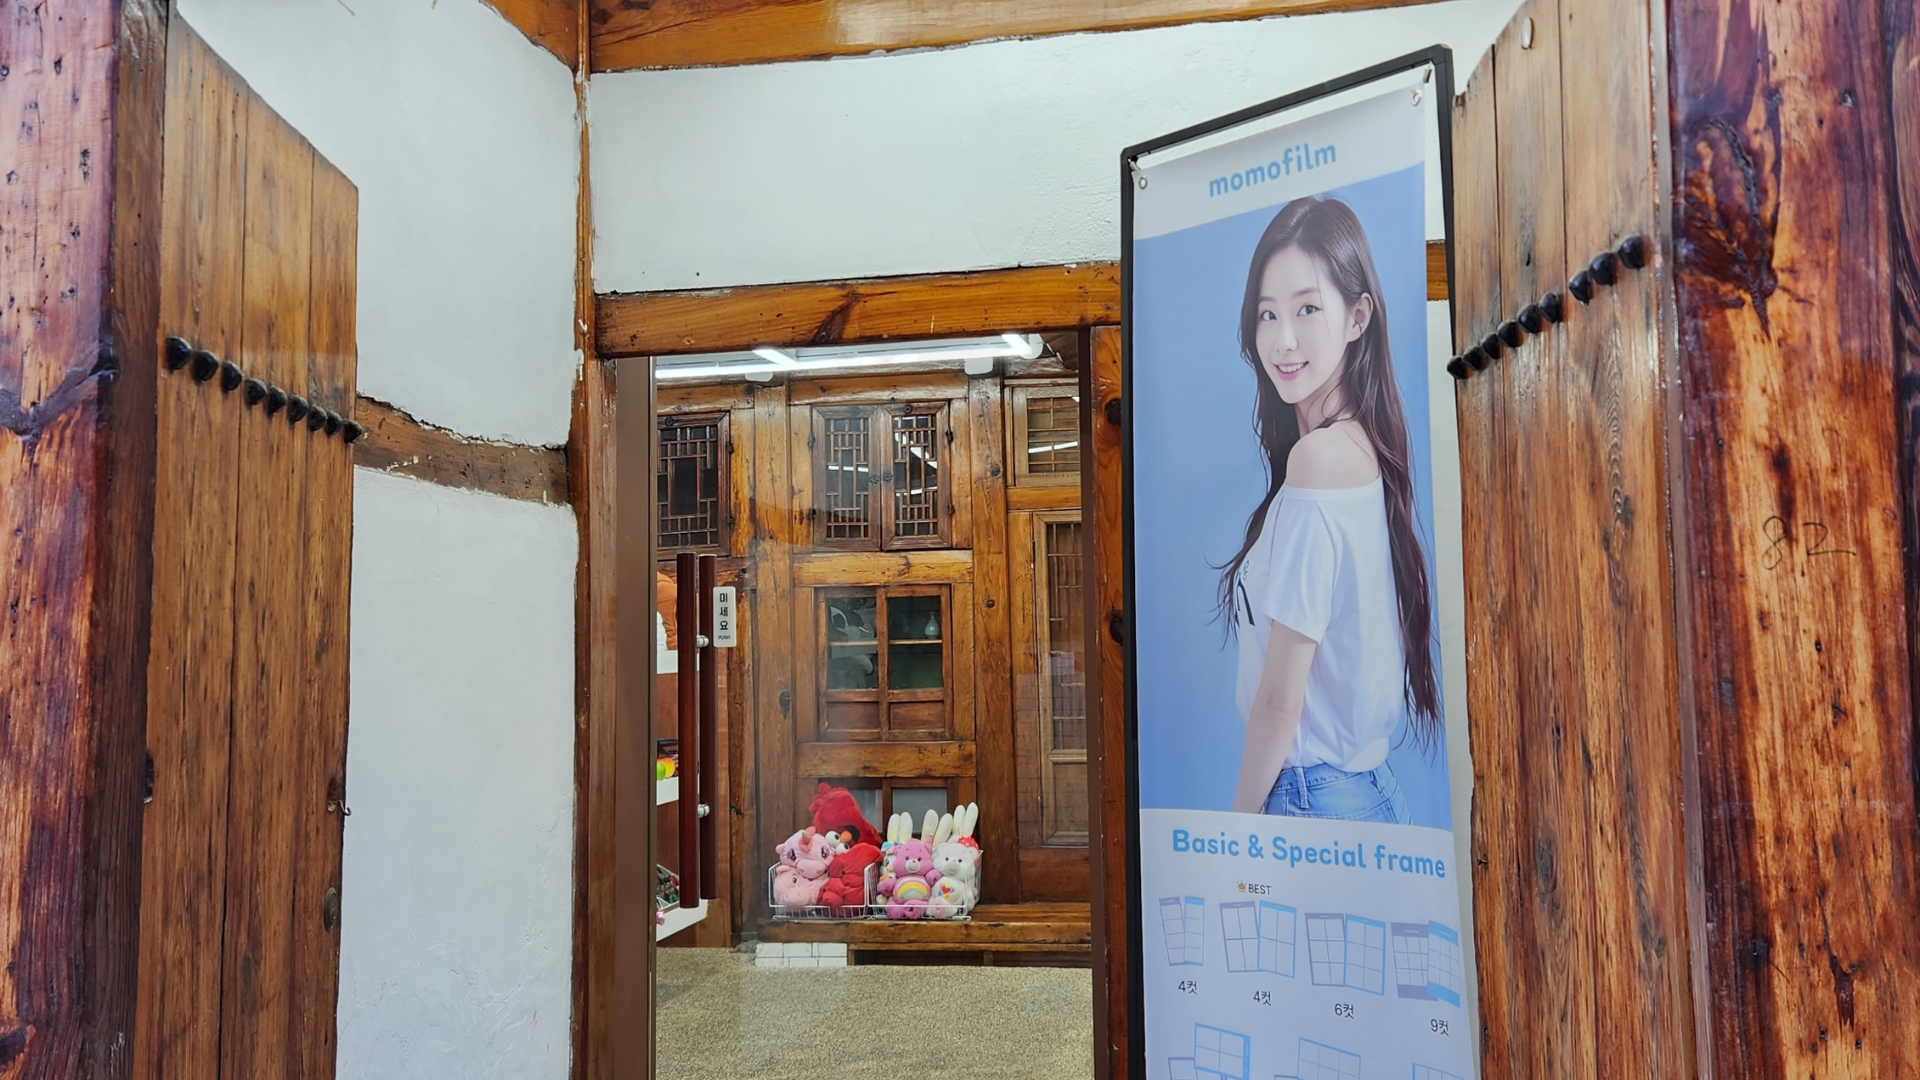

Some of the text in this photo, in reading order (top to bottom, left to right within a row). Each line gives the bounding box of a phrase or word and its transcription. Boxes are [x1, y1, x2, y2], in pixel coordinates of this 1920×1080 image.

[1208, 143, 1338, 198] momofilm
[719, 592, 729, 631] 미세요
[1172, 829, 1447, 878] Basic & Special frame
[1248, 883, 1272, 896] BEST
[1177, 980, 1198, 995] 4컷
[1253, 991, 1272, 1007] 4컷
[1334, 1003, 1354, 1020] 6컷
[1430, 1018, 1449, 1036] 9컷
